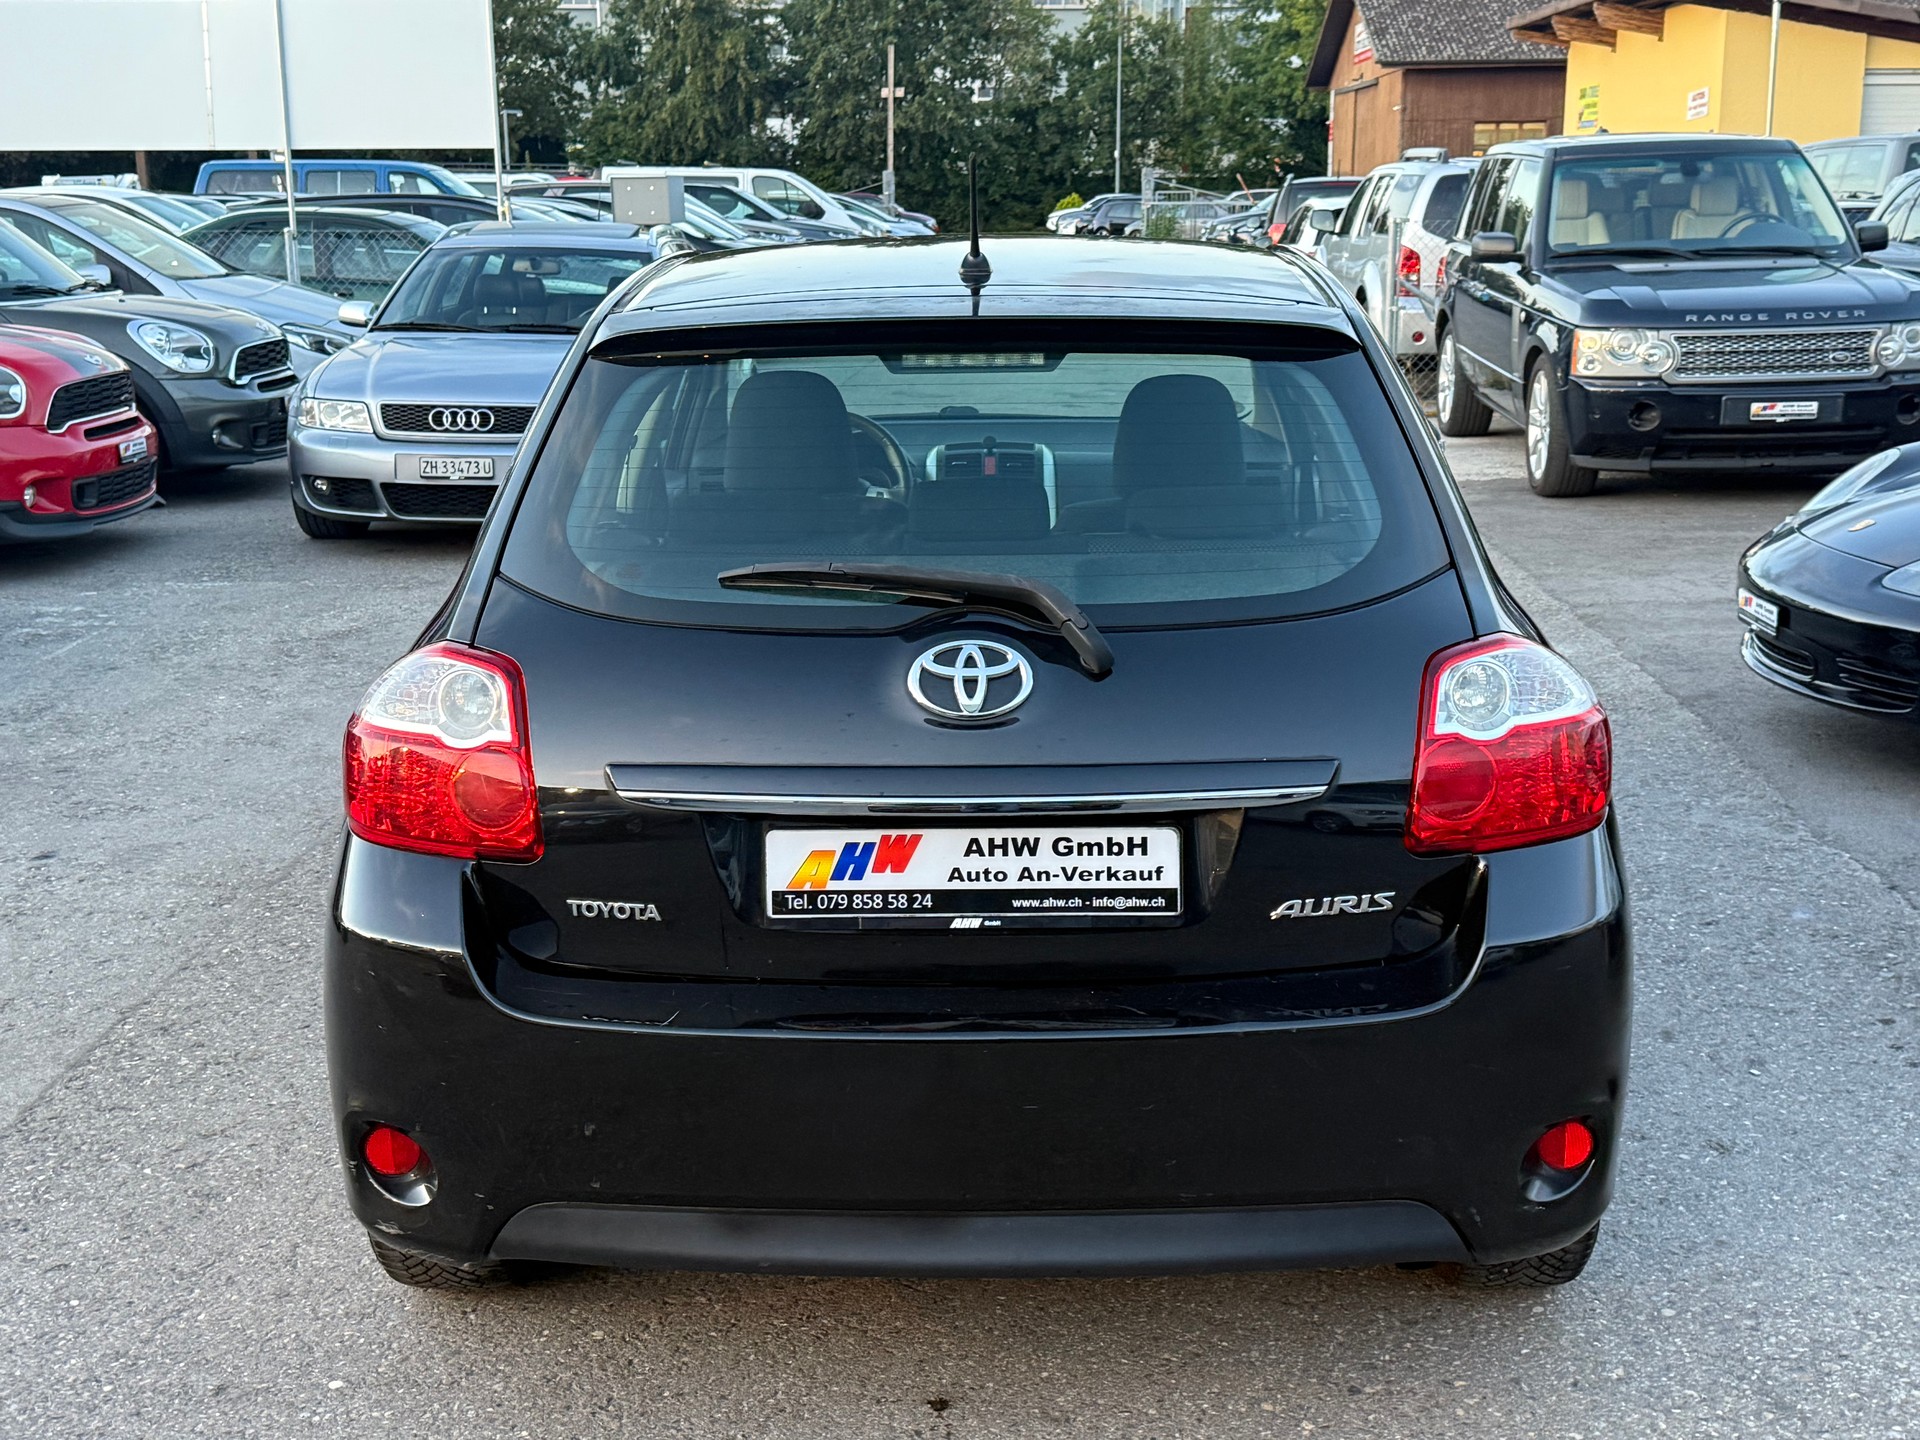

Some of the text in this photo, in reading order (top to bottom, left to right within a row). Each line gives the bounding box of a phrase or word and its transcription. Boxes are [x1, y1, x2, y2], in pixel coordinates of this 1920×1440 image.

[1685, 310, 1866, 322] RANGE ROVER
[963, 836, 1149, 857] AHW GmbH
[785, 834, 923, 889] AHW
[947, 866, 1164, 882] Auto An-Verkauf
[785, 893, 933, 909] Tel. 079 858 58 24
[1012, 896, 1082, 908] www.ahw.ch
[1092, 896, 1165, 909] info@ahw.ch
[1270, 892, 1396, 919] AURIS
[566, 899, 662, 921] TOYOTA
[949, 917, 983, 929] AHW
